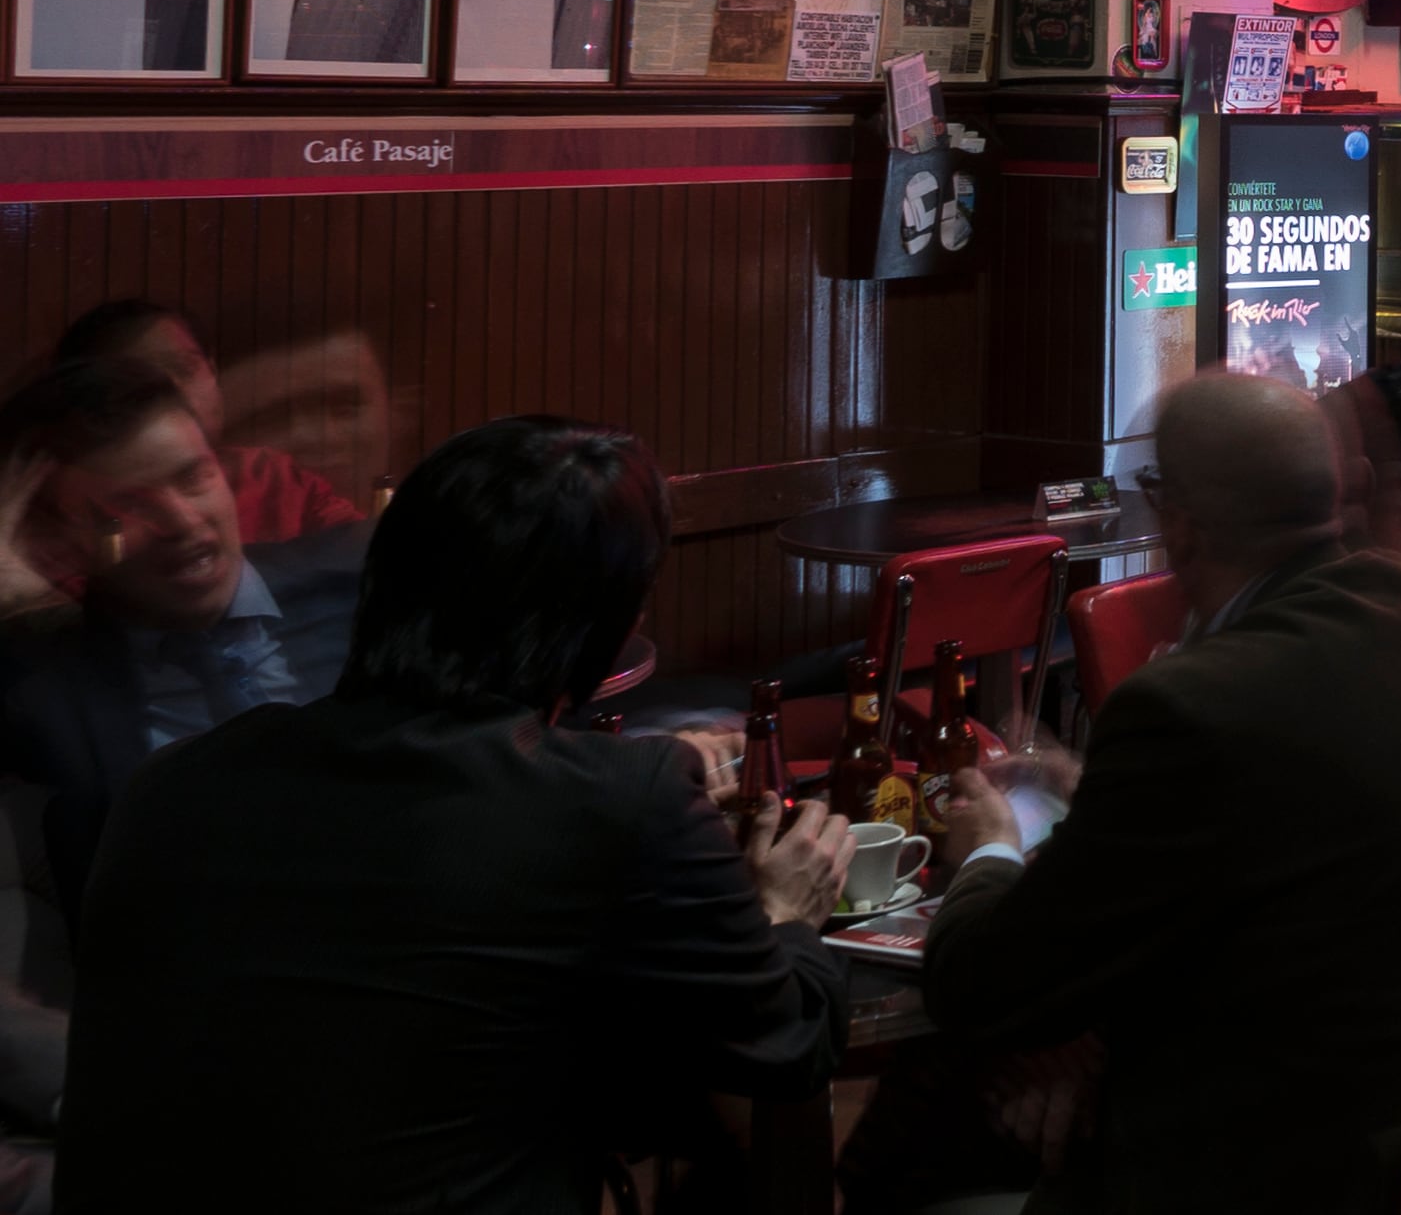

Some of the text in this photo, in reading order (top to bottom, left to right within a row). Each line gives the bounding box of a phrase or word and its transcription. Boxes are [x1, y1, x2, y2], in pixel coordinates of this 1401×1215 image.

[1237, 18, 1293, 33] EXTINTOR
[304, 139, 453, 170] Café Pasaje
[1228, 180, 1276, 196] CONVIÉRTETE
[1228, 197, 1324, 213] EN UN ROCK STAR Y GANA
[1226, 214, 1371, 245] 30 SEGUNDOS
[1226, 243, 1351, 275] DE FAMA EN
[1226, 298, 1320, 328] Rock in Rio
